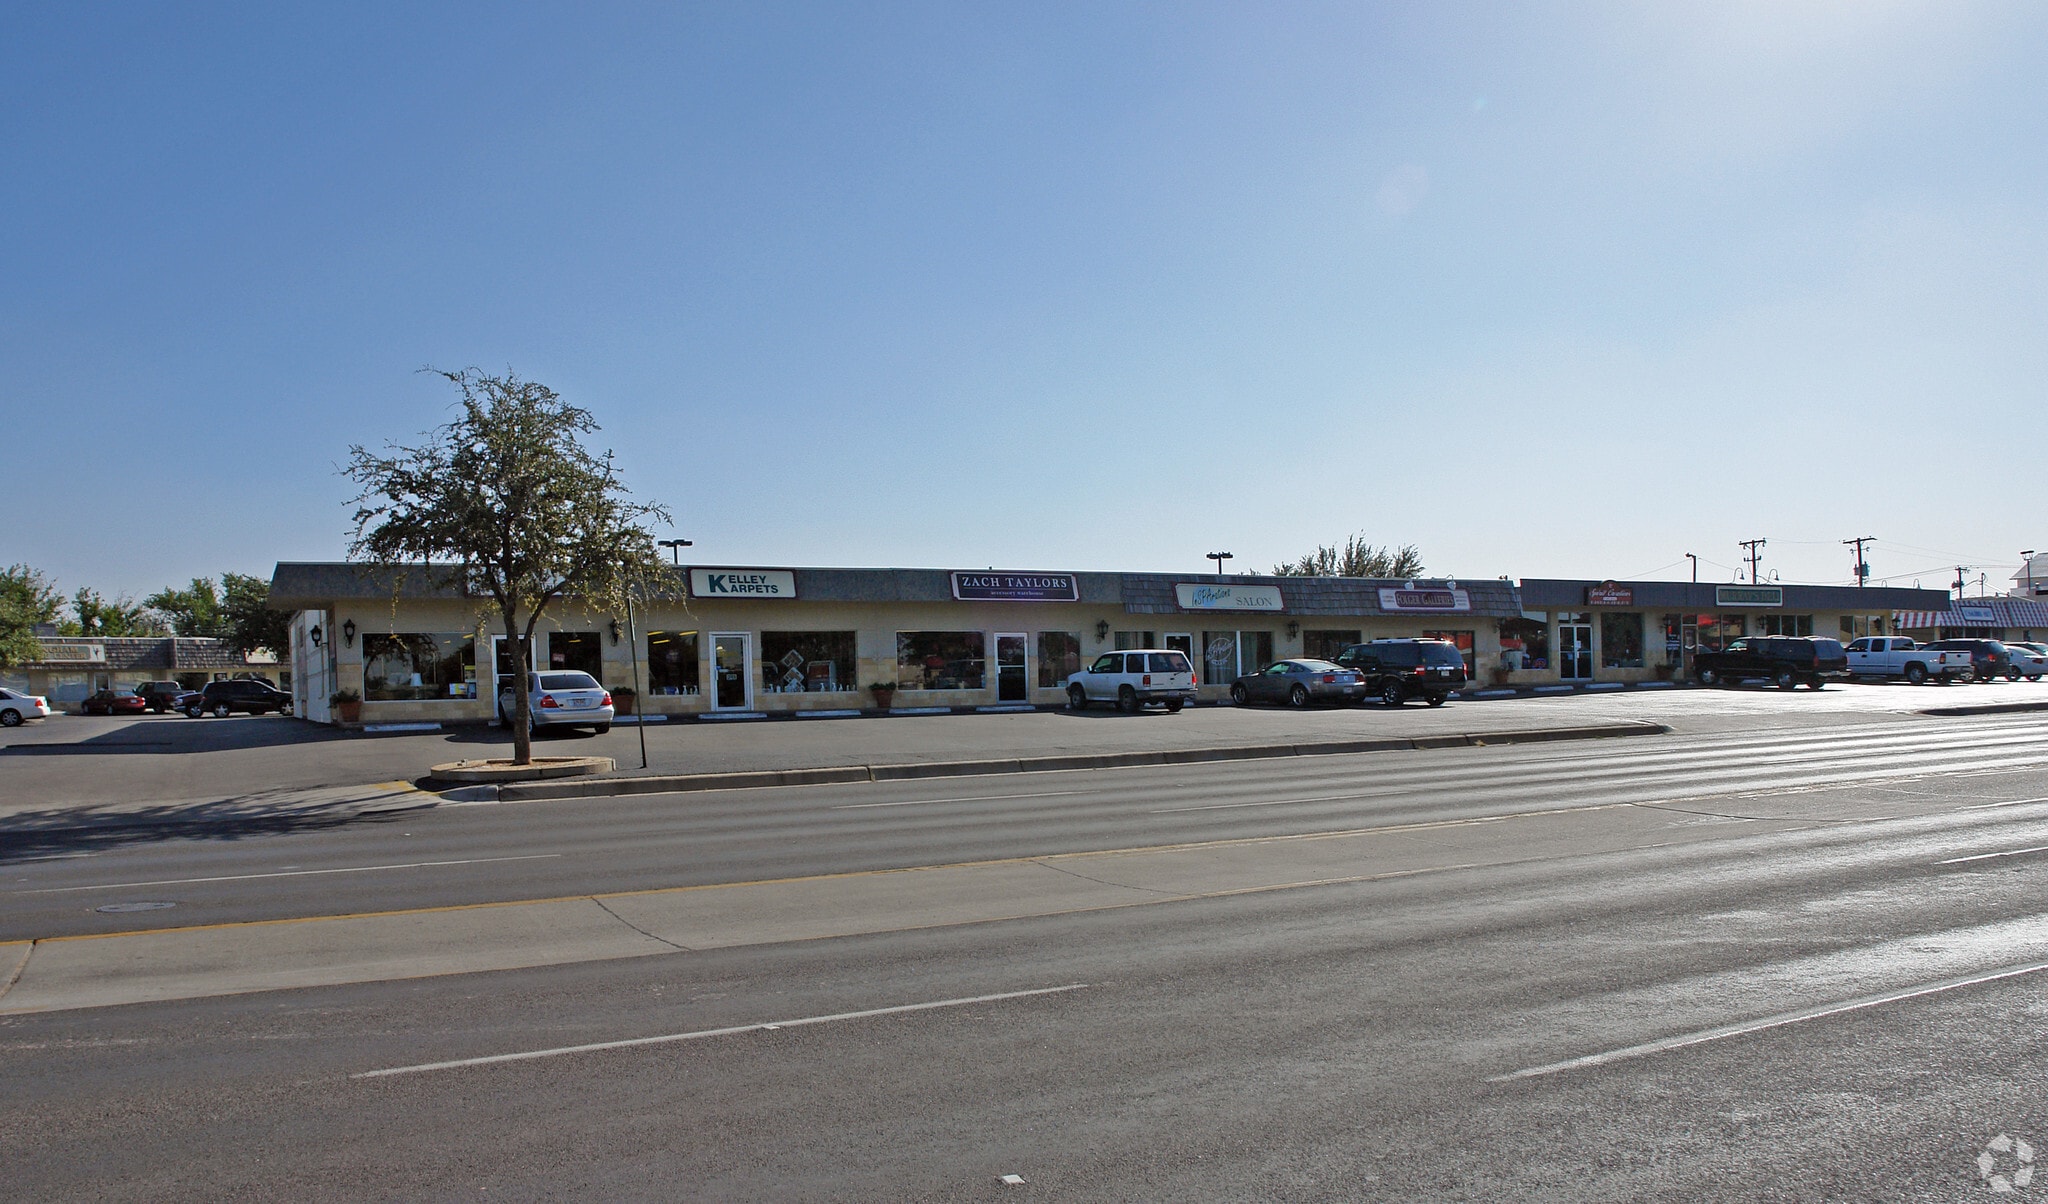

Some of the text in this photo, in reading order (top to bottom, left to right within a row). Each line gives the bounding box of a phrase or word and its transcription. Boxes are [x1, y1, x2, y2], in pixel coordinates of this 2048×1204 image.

[962, 577, 1067, 588] ZACH TAYLORS
[1236, 596, 1273, 607] SALON
